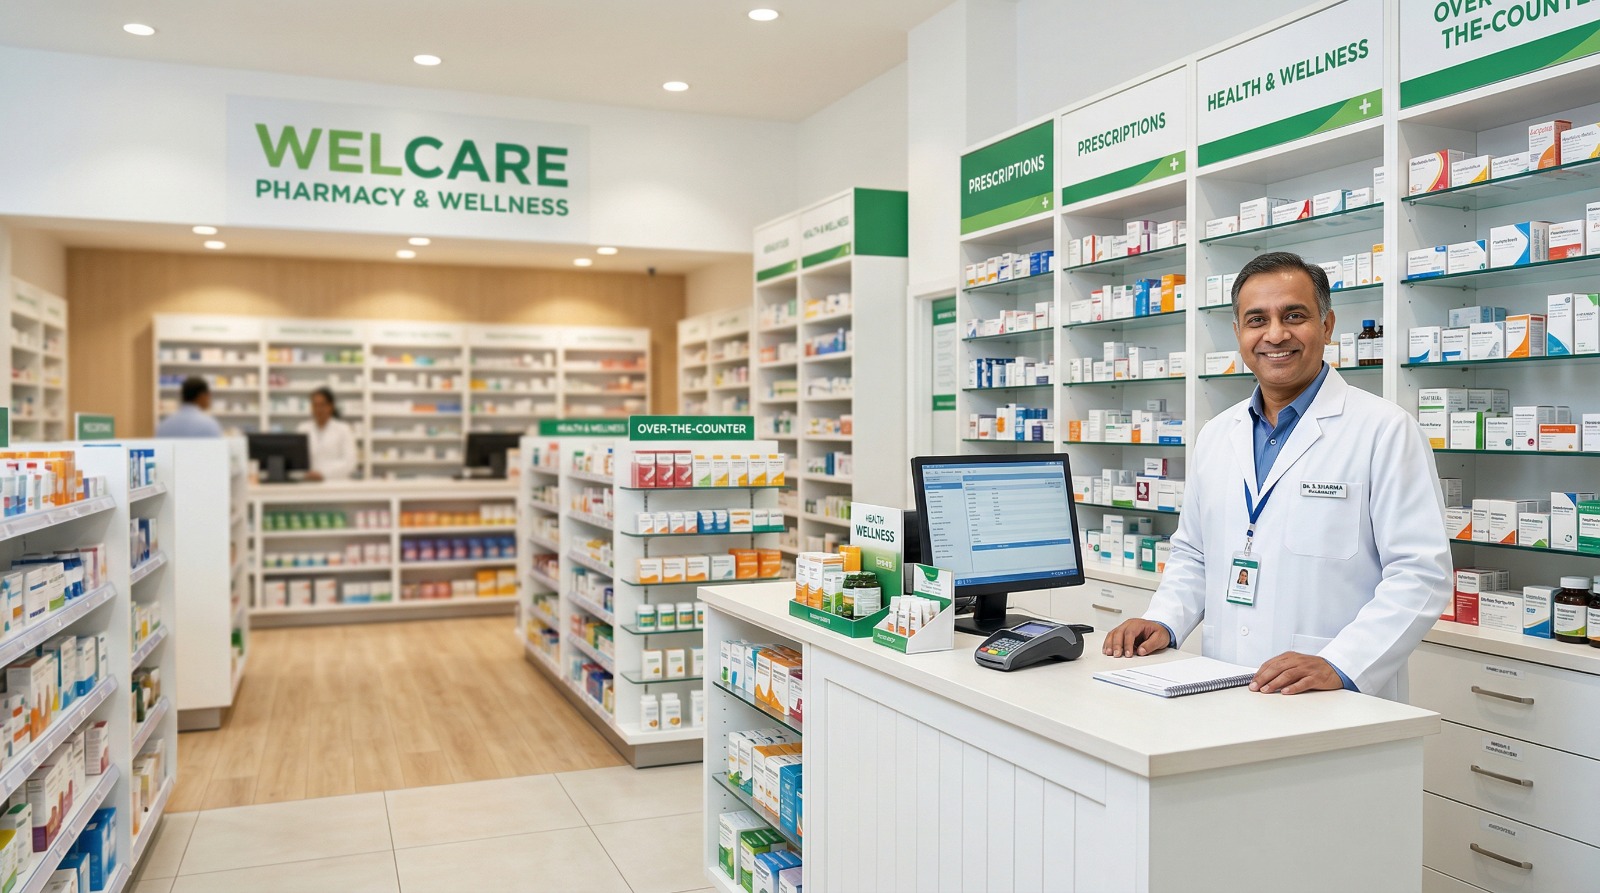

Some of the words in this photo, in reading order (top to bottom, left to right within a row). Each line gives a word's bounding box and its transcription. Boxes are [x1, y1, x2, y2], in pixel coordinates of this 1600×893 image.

[1442, 0, 1600, 49] THE-COUN
[1207, 77, 1261, 112] HEALTH
[1265, 72, 1275, 91] &
[1279, 38, 1369, 86] WELLNESS
[1077, 112, 1166, 157] PRESCRIPTIONS
[255, 123, 568, 188] WELCARE
[968, 154, 1045, 194] PRESCRIPTIONS
[256, 179, 405, 206] PHARMACY
[413, 189, 429, 208] &
[438, 191, 569, 217] WELLNESS
[637, 423, 747, 434] OVER-THE-COUNTER
[855, 524, 895, 543] WELLNESS
[865, 513, 884, 525] HEALTH
